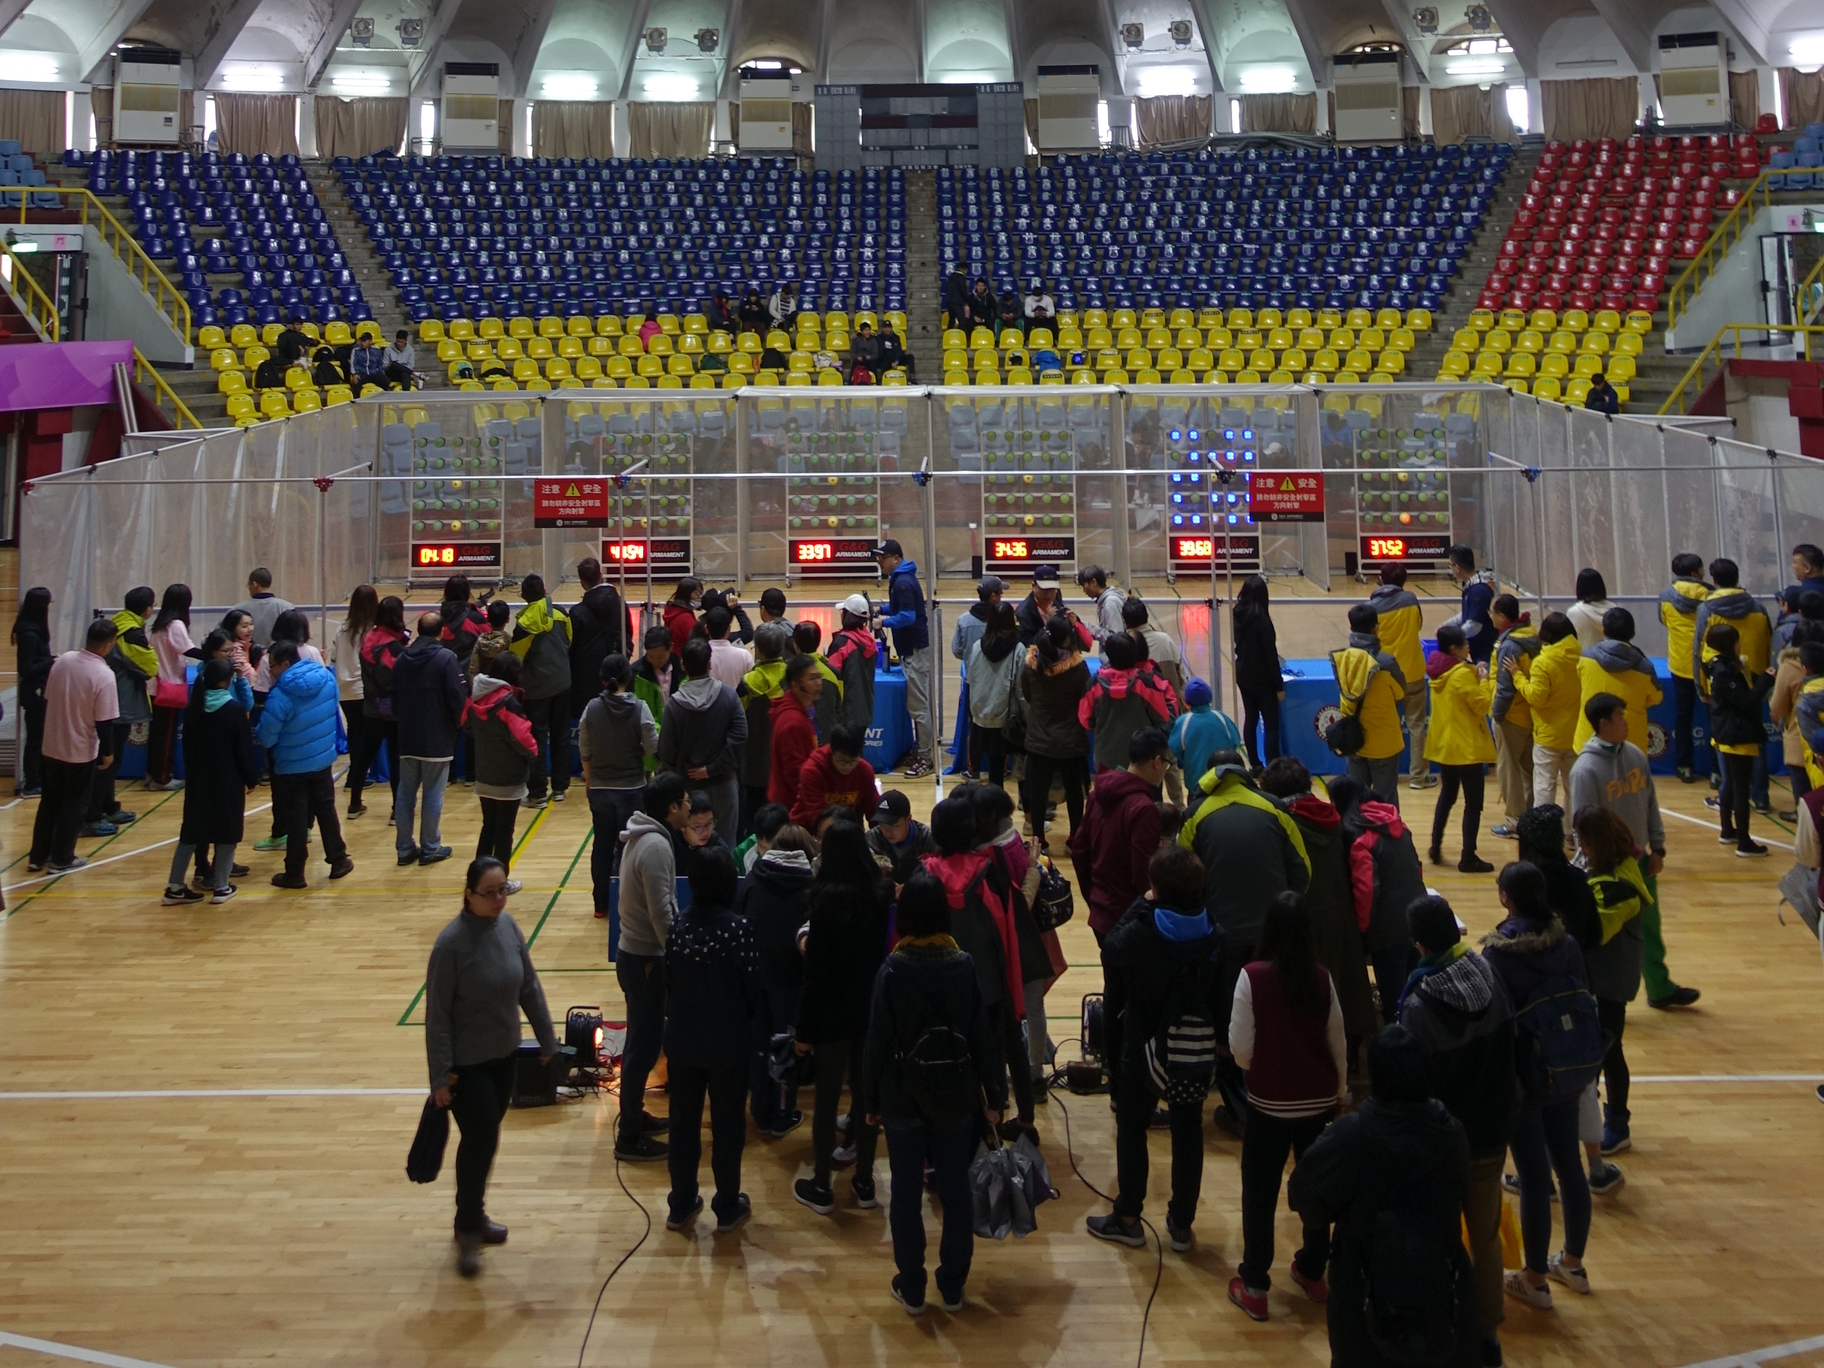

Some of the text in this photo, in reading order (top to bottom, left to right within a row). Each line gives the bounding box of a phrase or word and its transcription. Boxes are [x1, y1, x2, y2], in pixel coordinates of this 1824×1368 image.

[1256, 478, 1317, 488] 注意 安全
[541, 484, 602, 494] 注意 安全
[1273, 502, 1300, 510] 方向射擊
[652, 542, 680, 551] G&G
[840, 542, 868, 551] G&G
[1036, 540, 1064, 549] G&G
[1411, 539, 1440, 547] G&G
[463, 546, 490, 555] G&G
